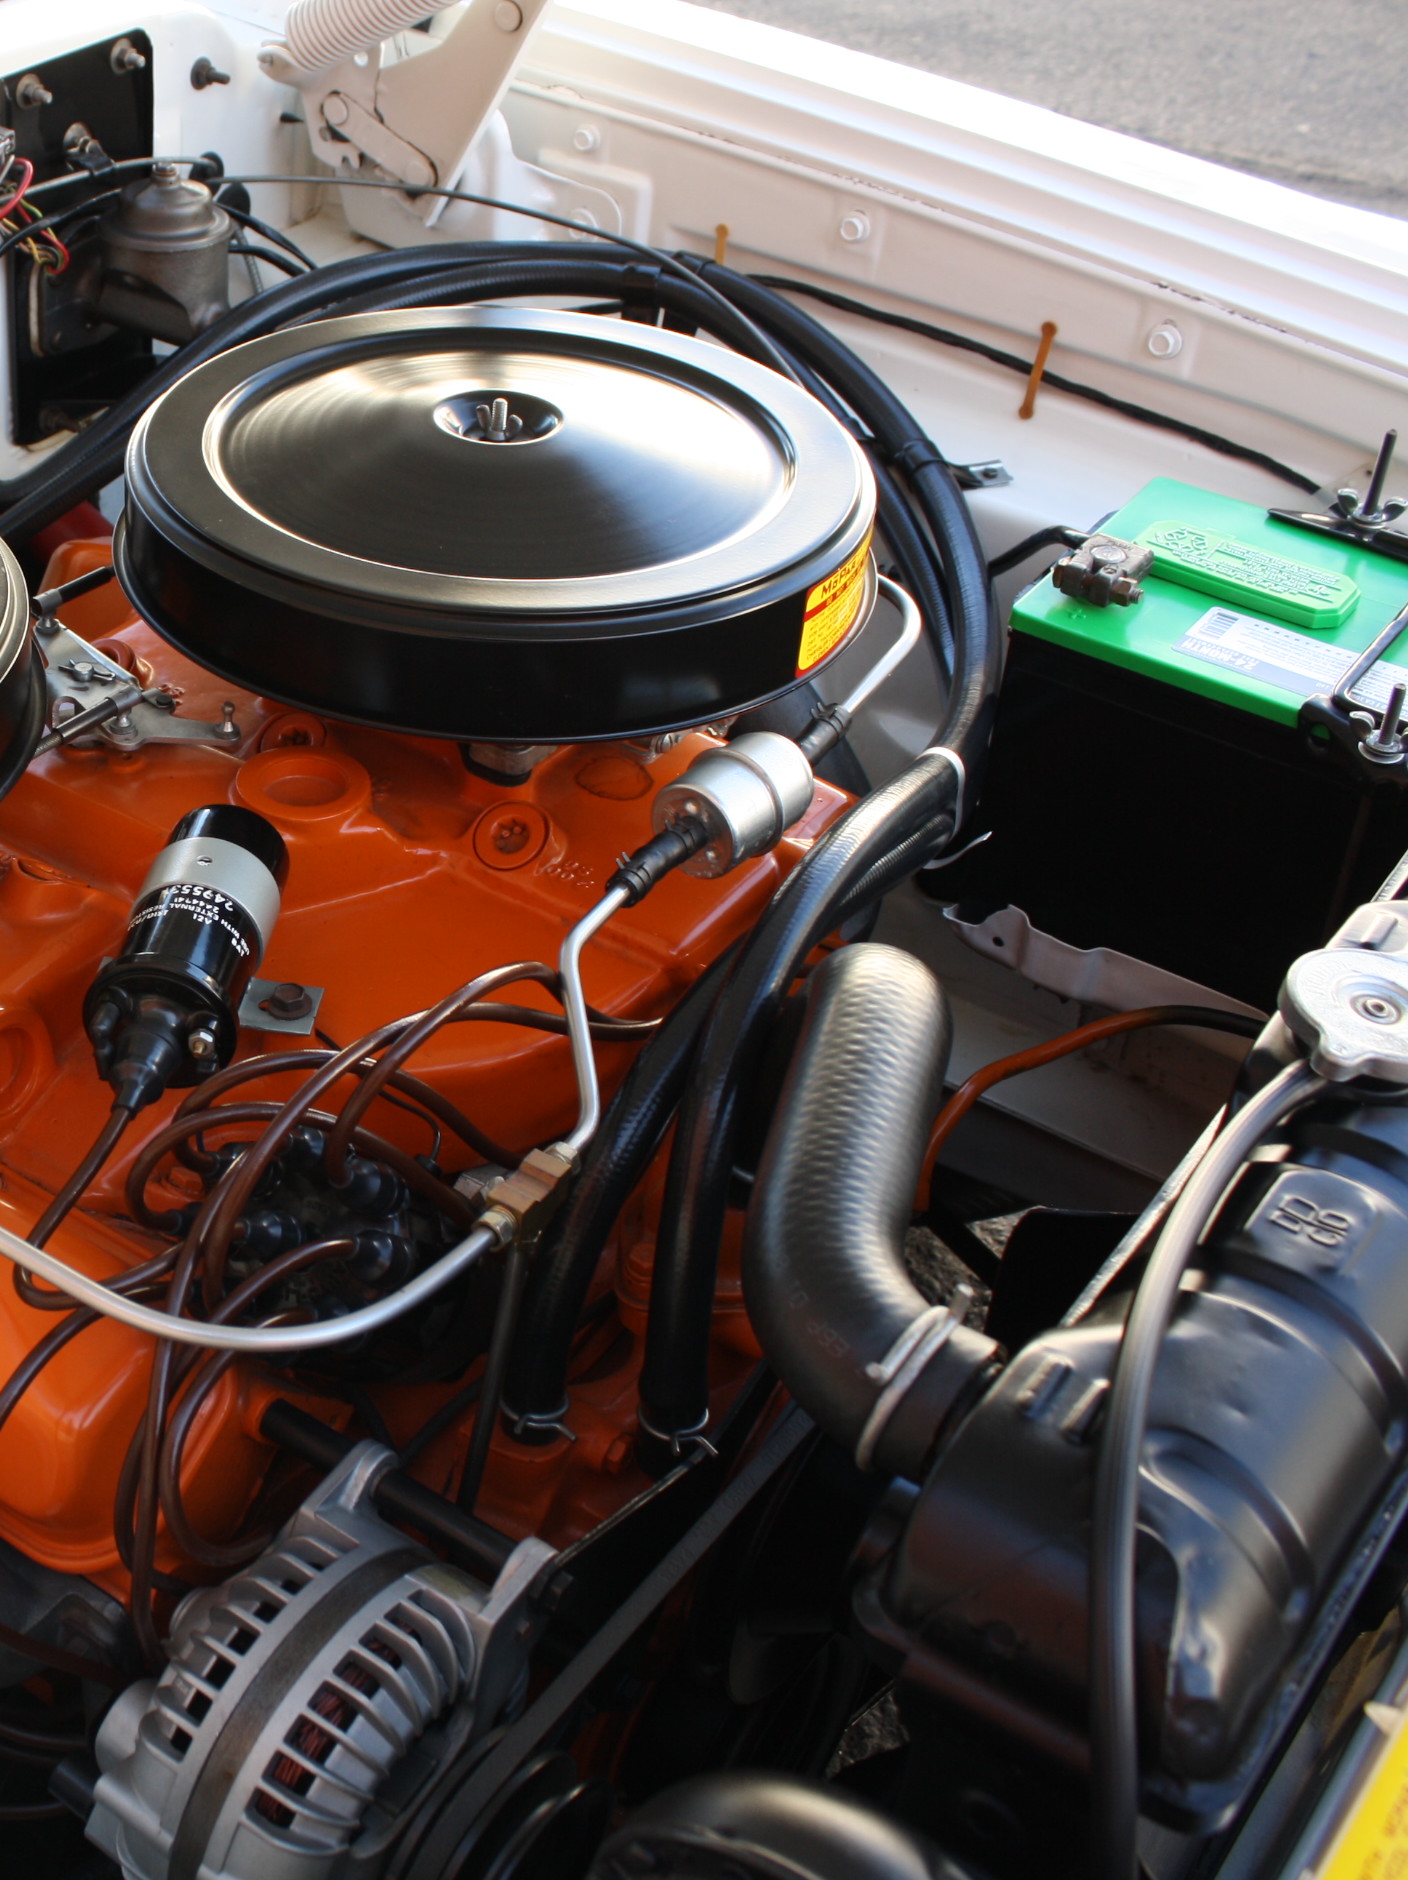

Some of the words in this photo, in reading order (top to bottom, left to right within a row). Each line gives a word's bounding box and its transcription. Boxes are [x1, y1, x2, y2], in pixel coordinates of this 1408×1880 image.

[169, 903, 219, 920] EXTERNAL
[192, 913, 213, 925] 12V
[220, 918, 241, 940] WITH
